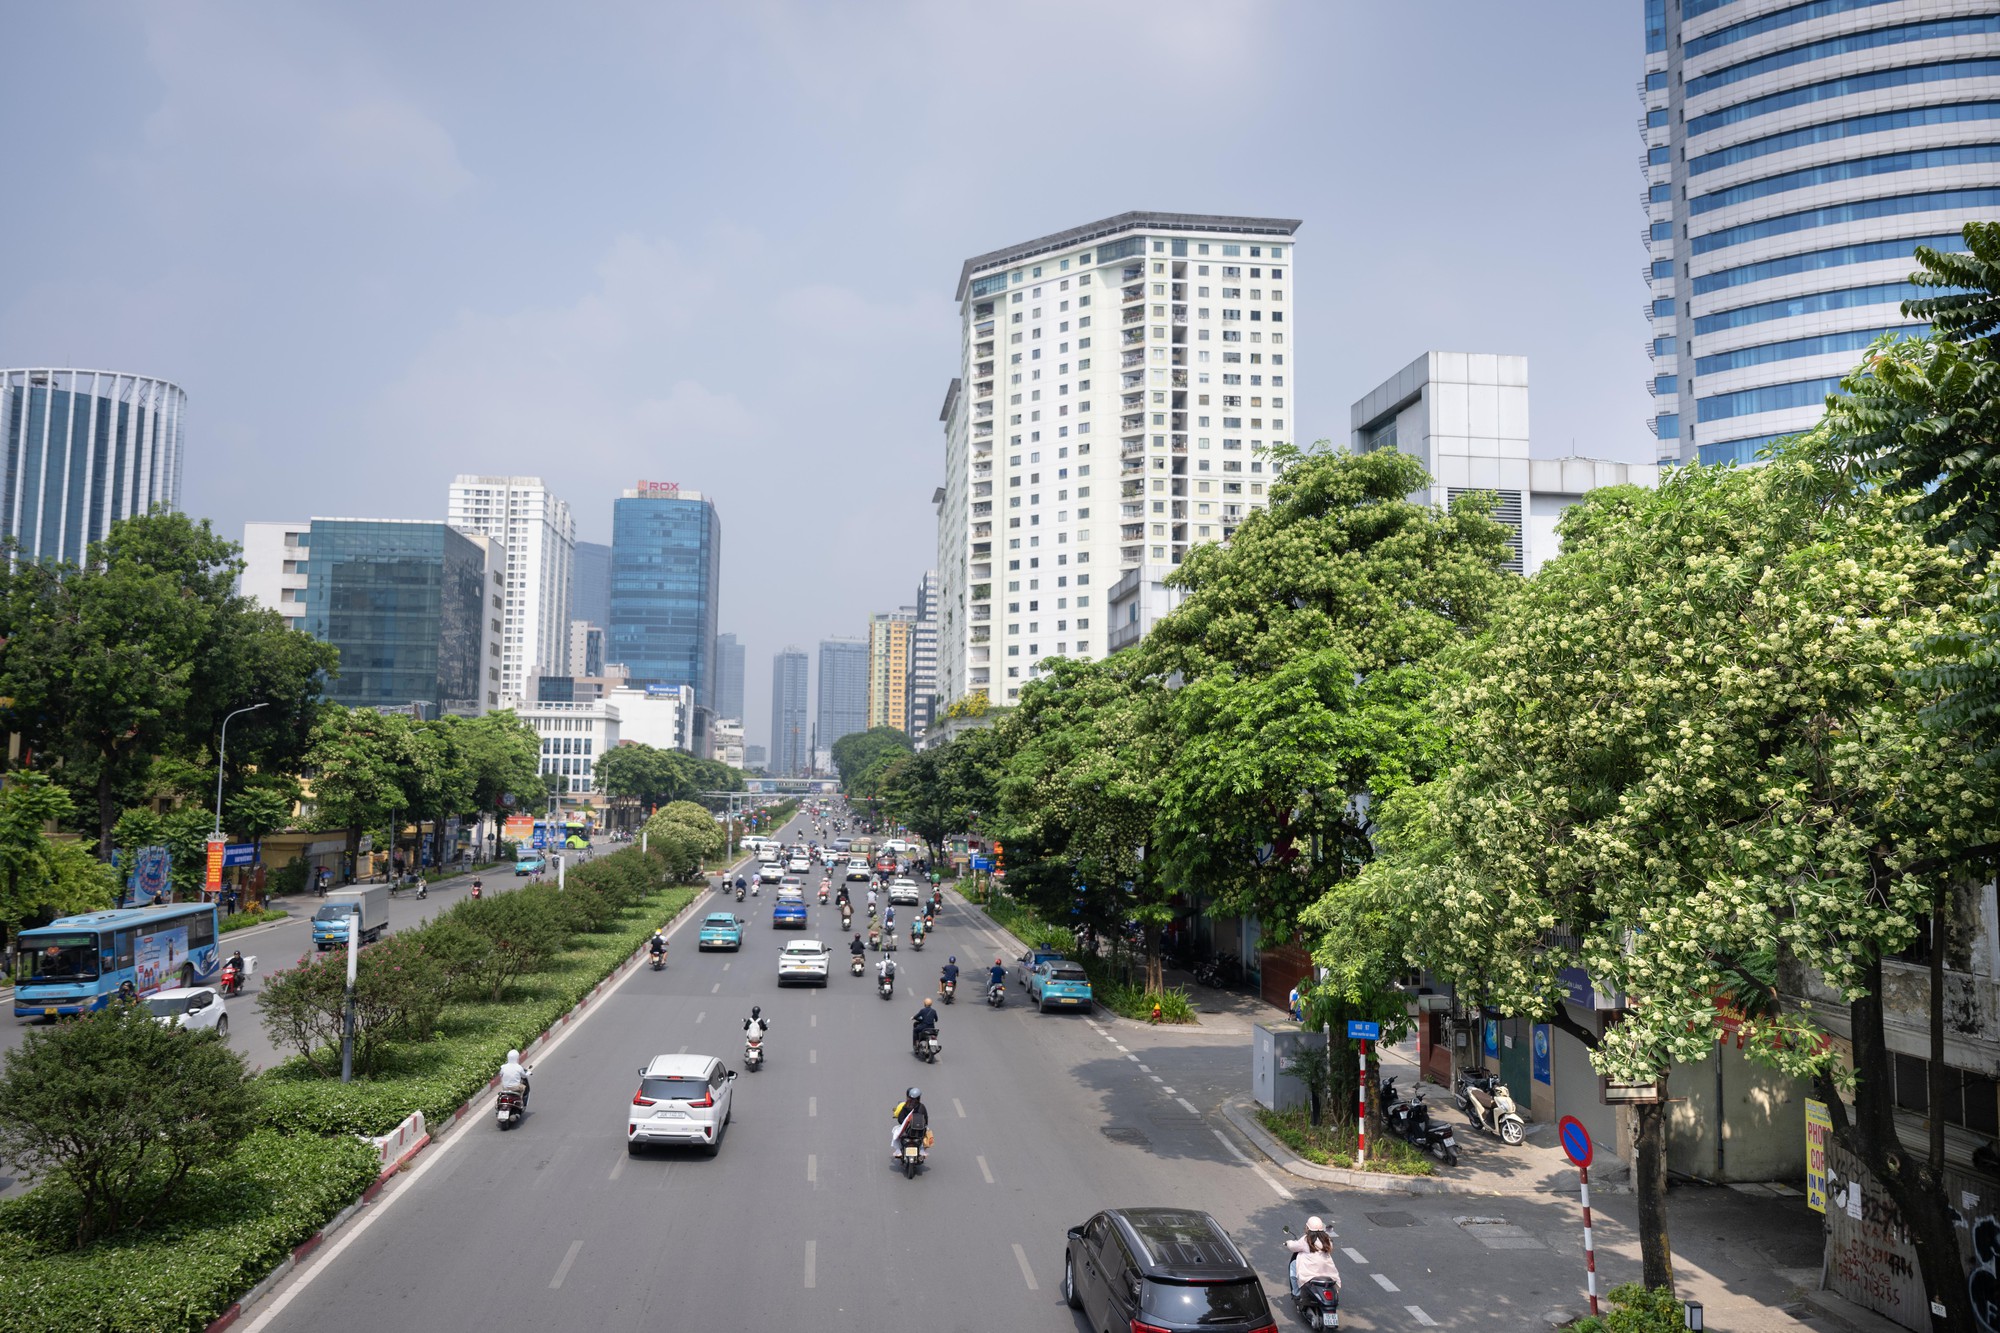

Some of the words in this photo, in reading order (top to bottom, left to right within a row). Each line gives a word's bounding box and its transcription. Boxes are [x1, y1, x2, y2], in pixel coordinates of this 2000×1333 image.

[650, 482, 679, 491] ROX
[1808, 1121, 1831, 1146] PHO
[1809, 1173, 1816, 1189] IN
